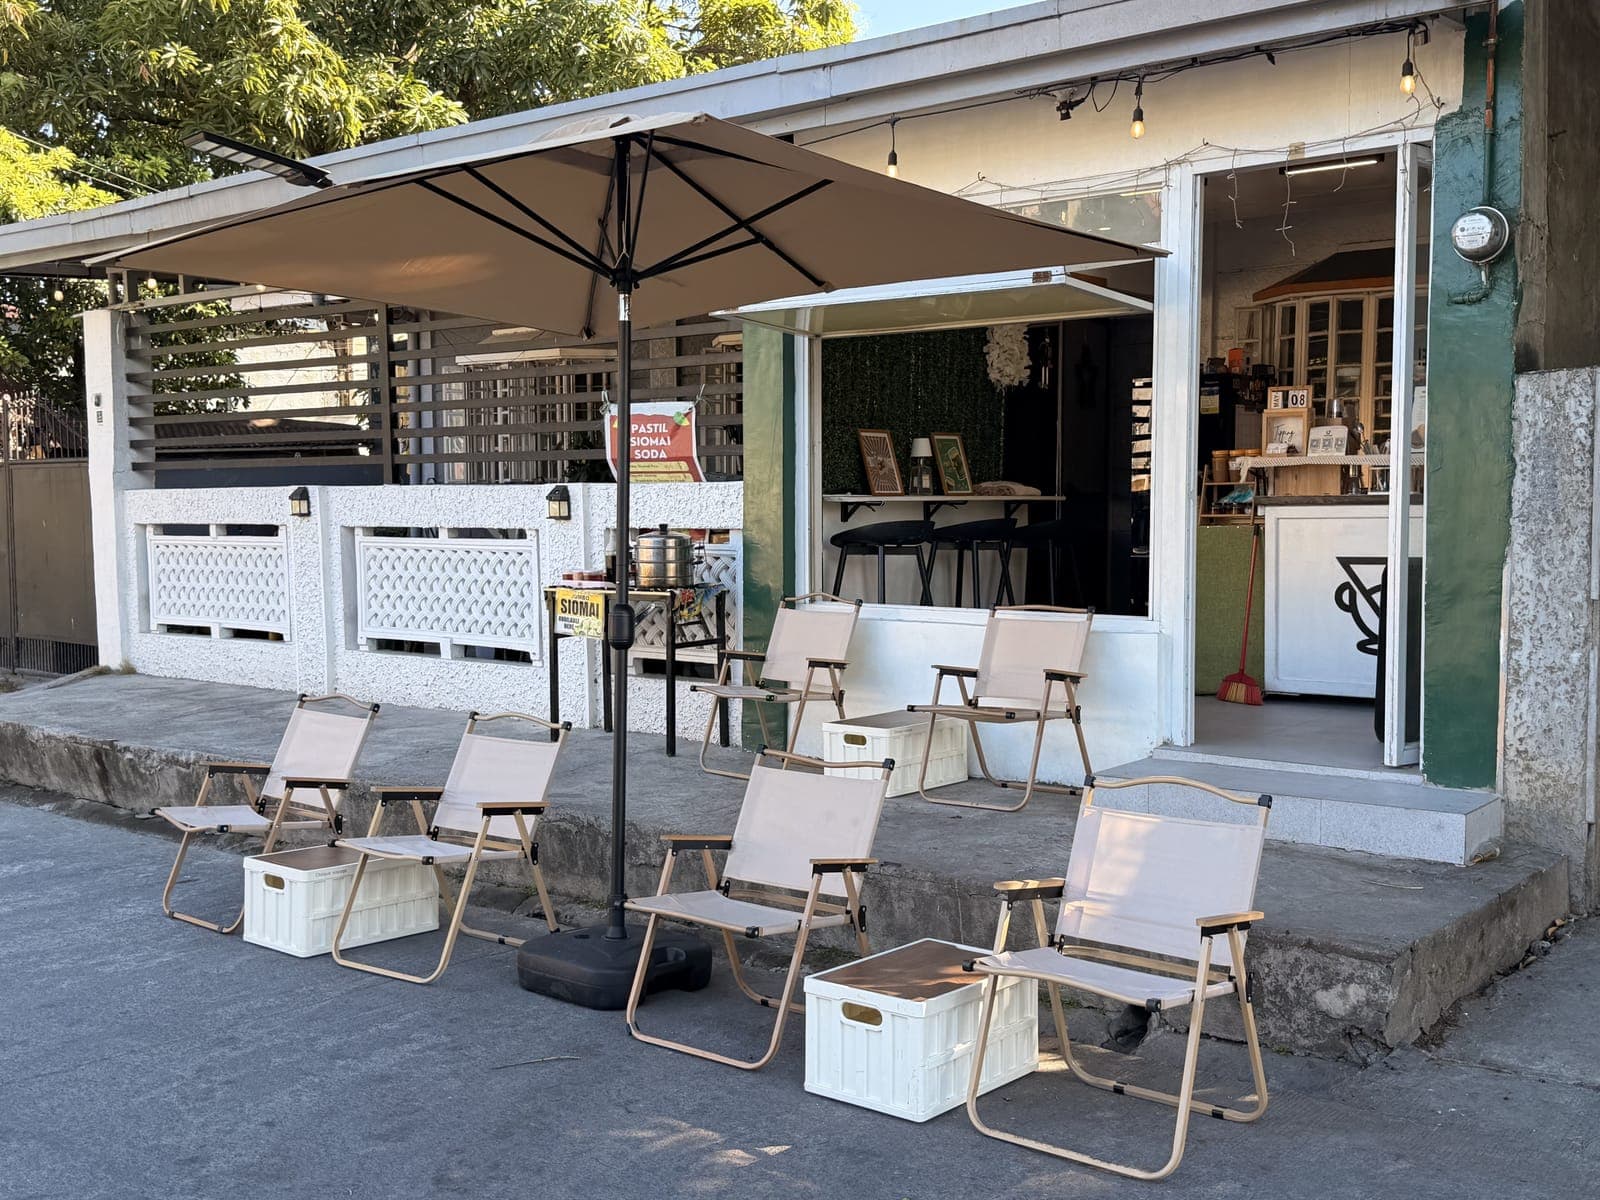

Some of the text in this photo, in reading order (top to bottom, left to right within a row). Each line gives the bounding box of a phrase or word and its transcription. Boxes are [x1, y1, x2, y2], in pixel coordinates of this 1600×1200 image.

[1291, 394, 1305, 406] 08
[631, 423, 668, 433] PASTIL
[630, 436, 671, 446] SIOMAI
[634, 449, 668, 459] SODA
[560, 598, 600, 619] SIOMAI
